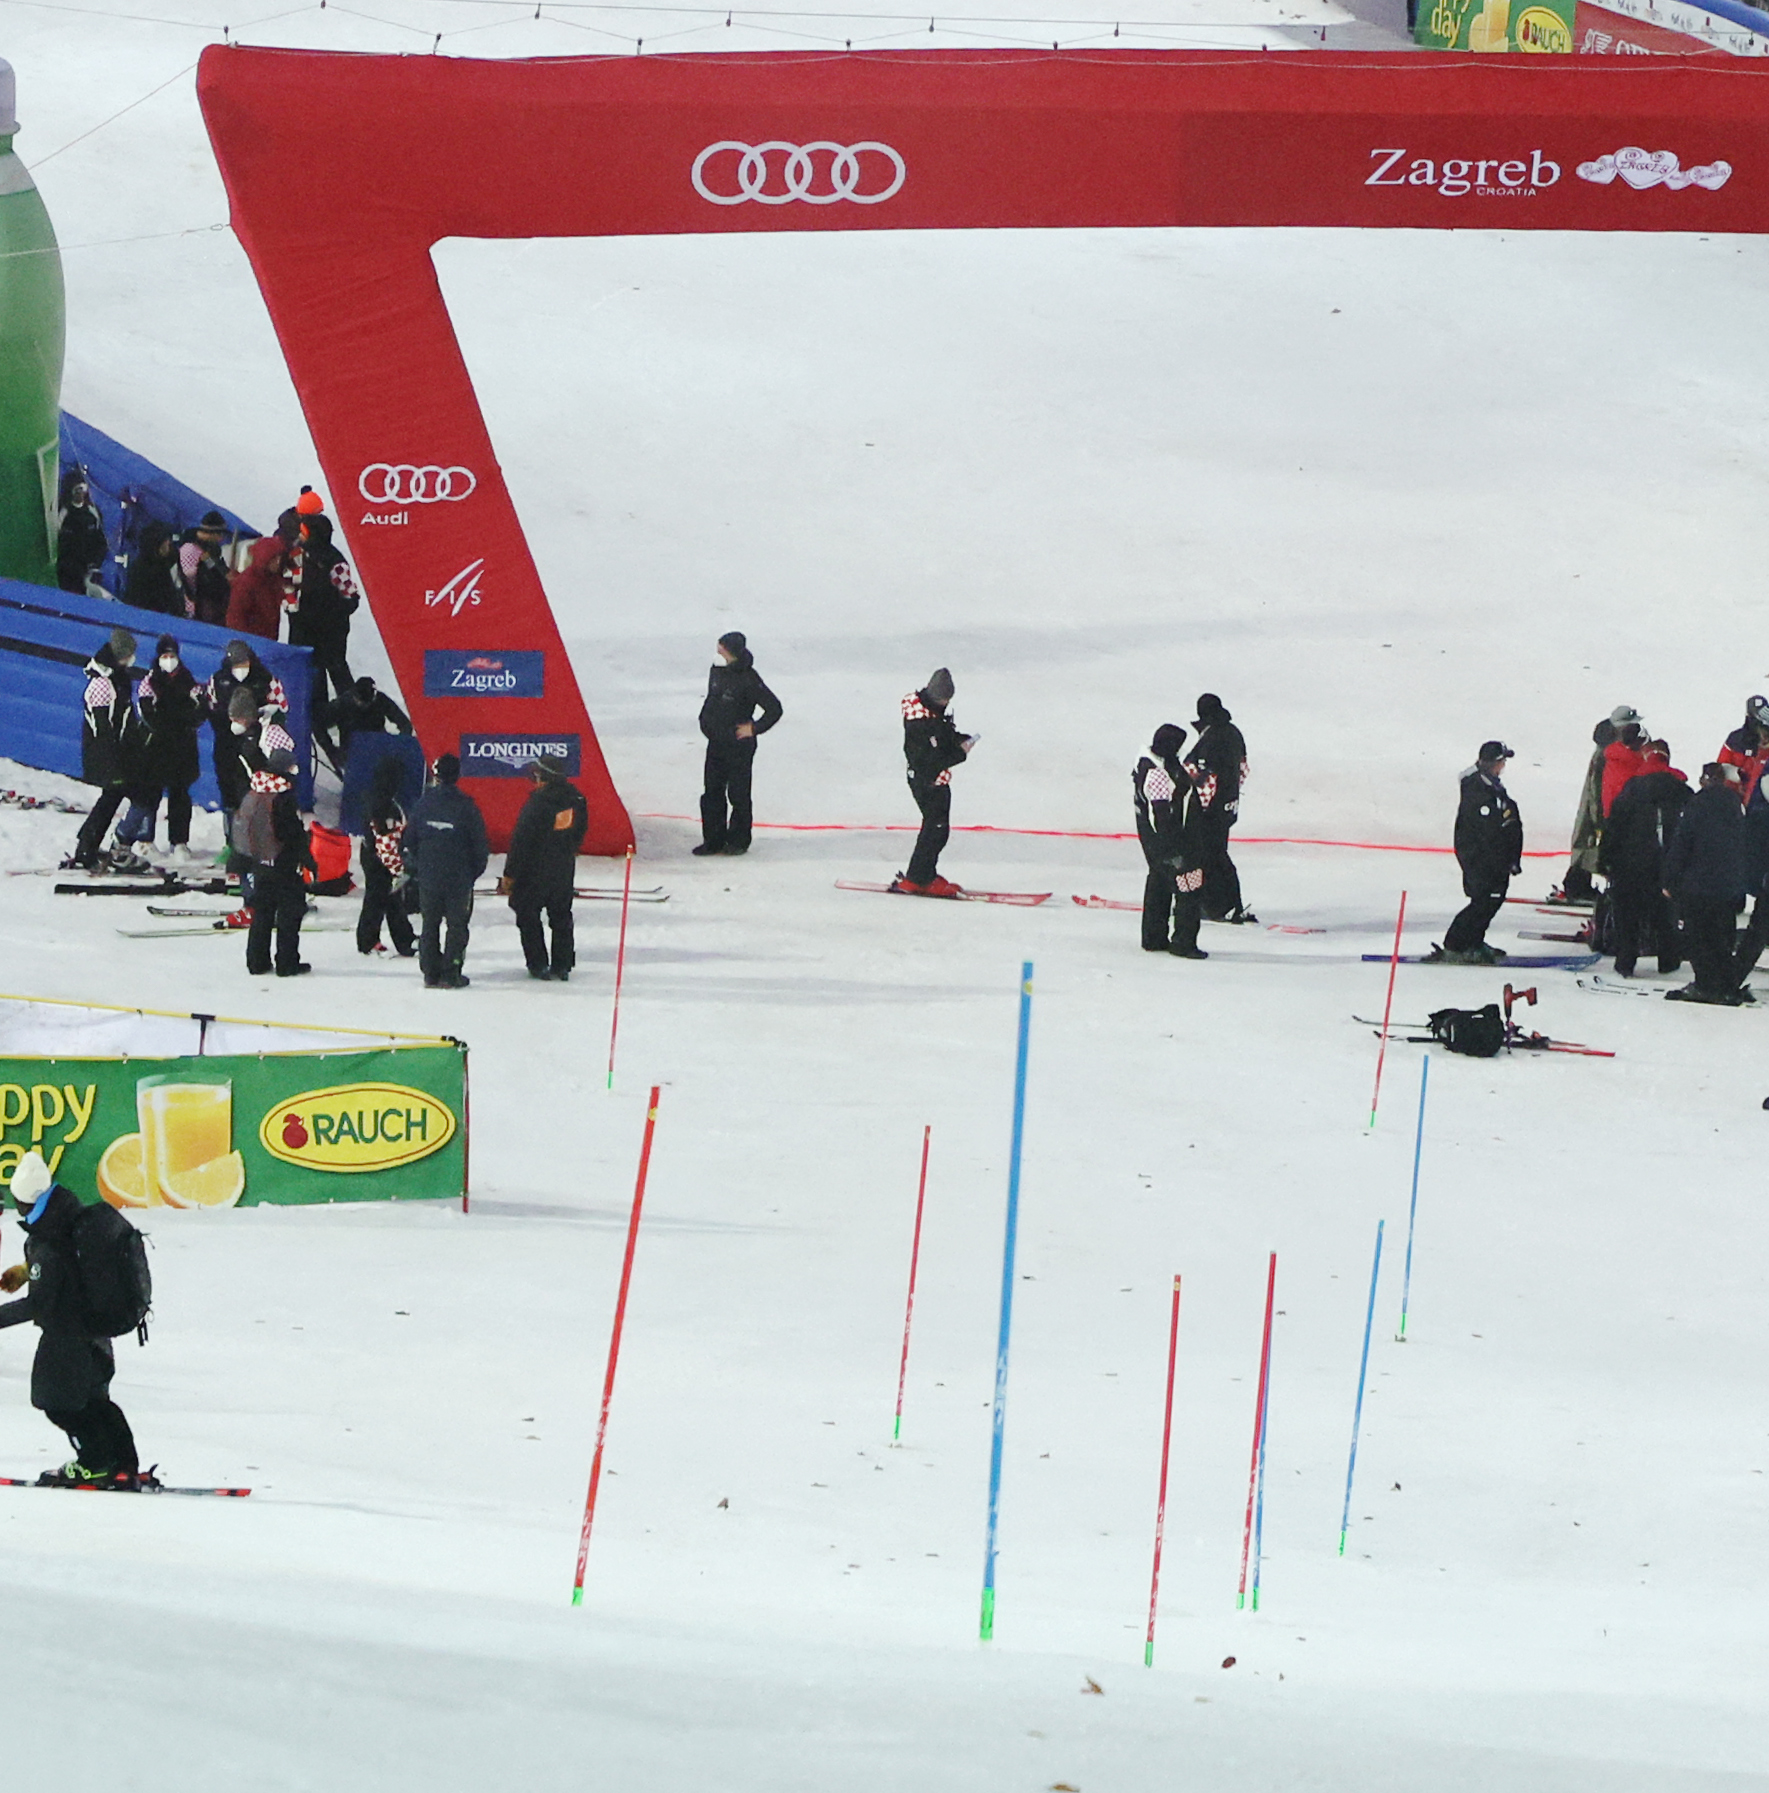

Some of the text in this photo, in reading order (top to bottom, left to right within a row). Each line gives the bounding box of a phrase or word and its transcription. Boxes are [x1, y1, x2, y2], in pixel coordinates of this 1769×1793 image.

[1432, 0, 1462, 49] day
[1363, 148, 1561, 197] Zagreb
[1476, 186, 1537, 197] CROATIA
[360, 511, 409, 526] Audi
[450, 668, 517, 693] Zagreb
[468, 742, 568, 758] LONGINES
[312, 1107, 429, 1147] RAUCH
